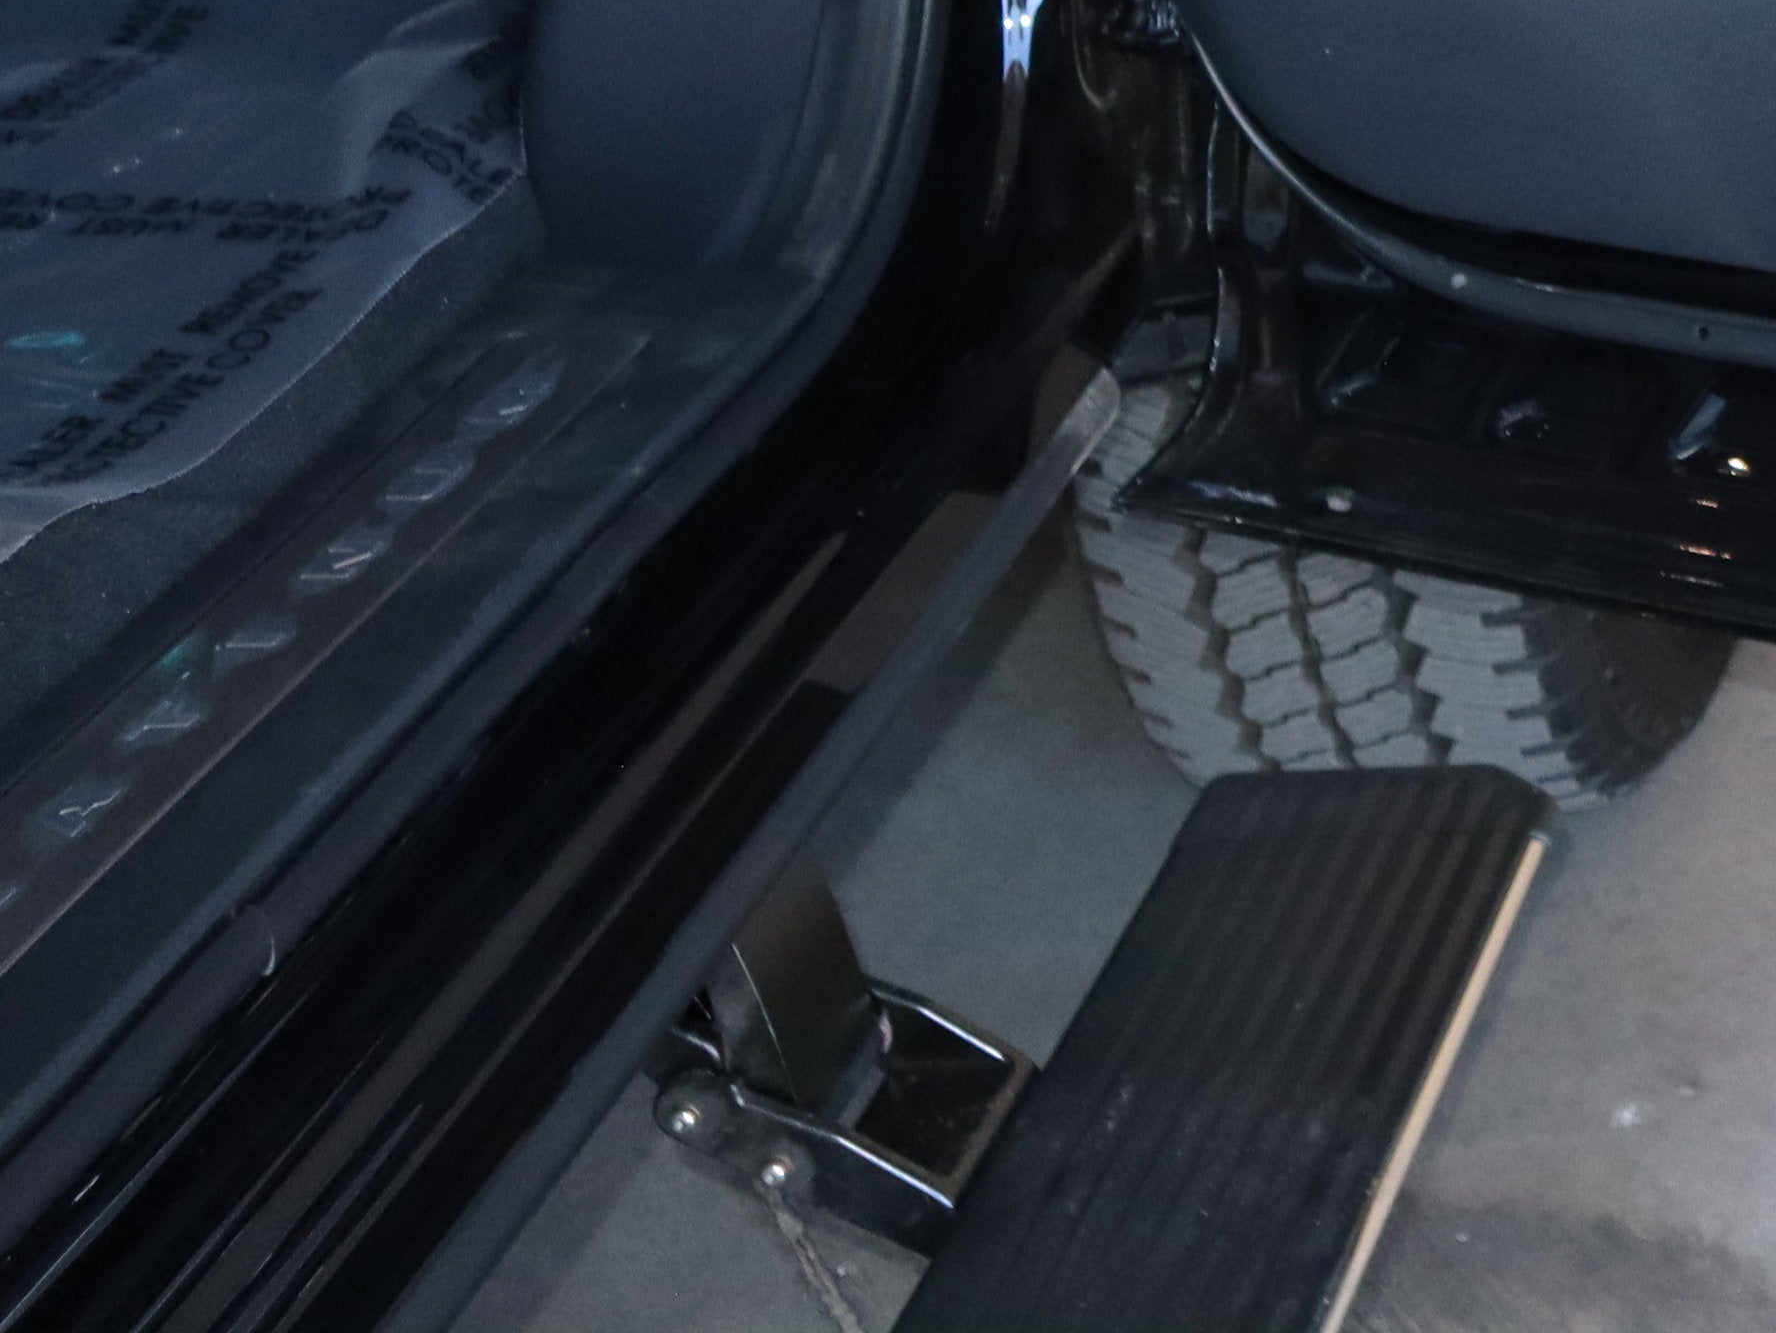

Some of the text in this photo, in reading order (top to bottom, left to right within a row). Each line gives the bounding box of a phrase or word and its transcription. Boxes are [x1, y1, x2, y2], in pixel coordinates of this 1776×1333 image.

[99, 348, 192, 402] MUST
[178, 248, 319, 334] REMOVE
[205, 287, 323, 371] COVER
[0, 347, 566, 915] ATINUM
